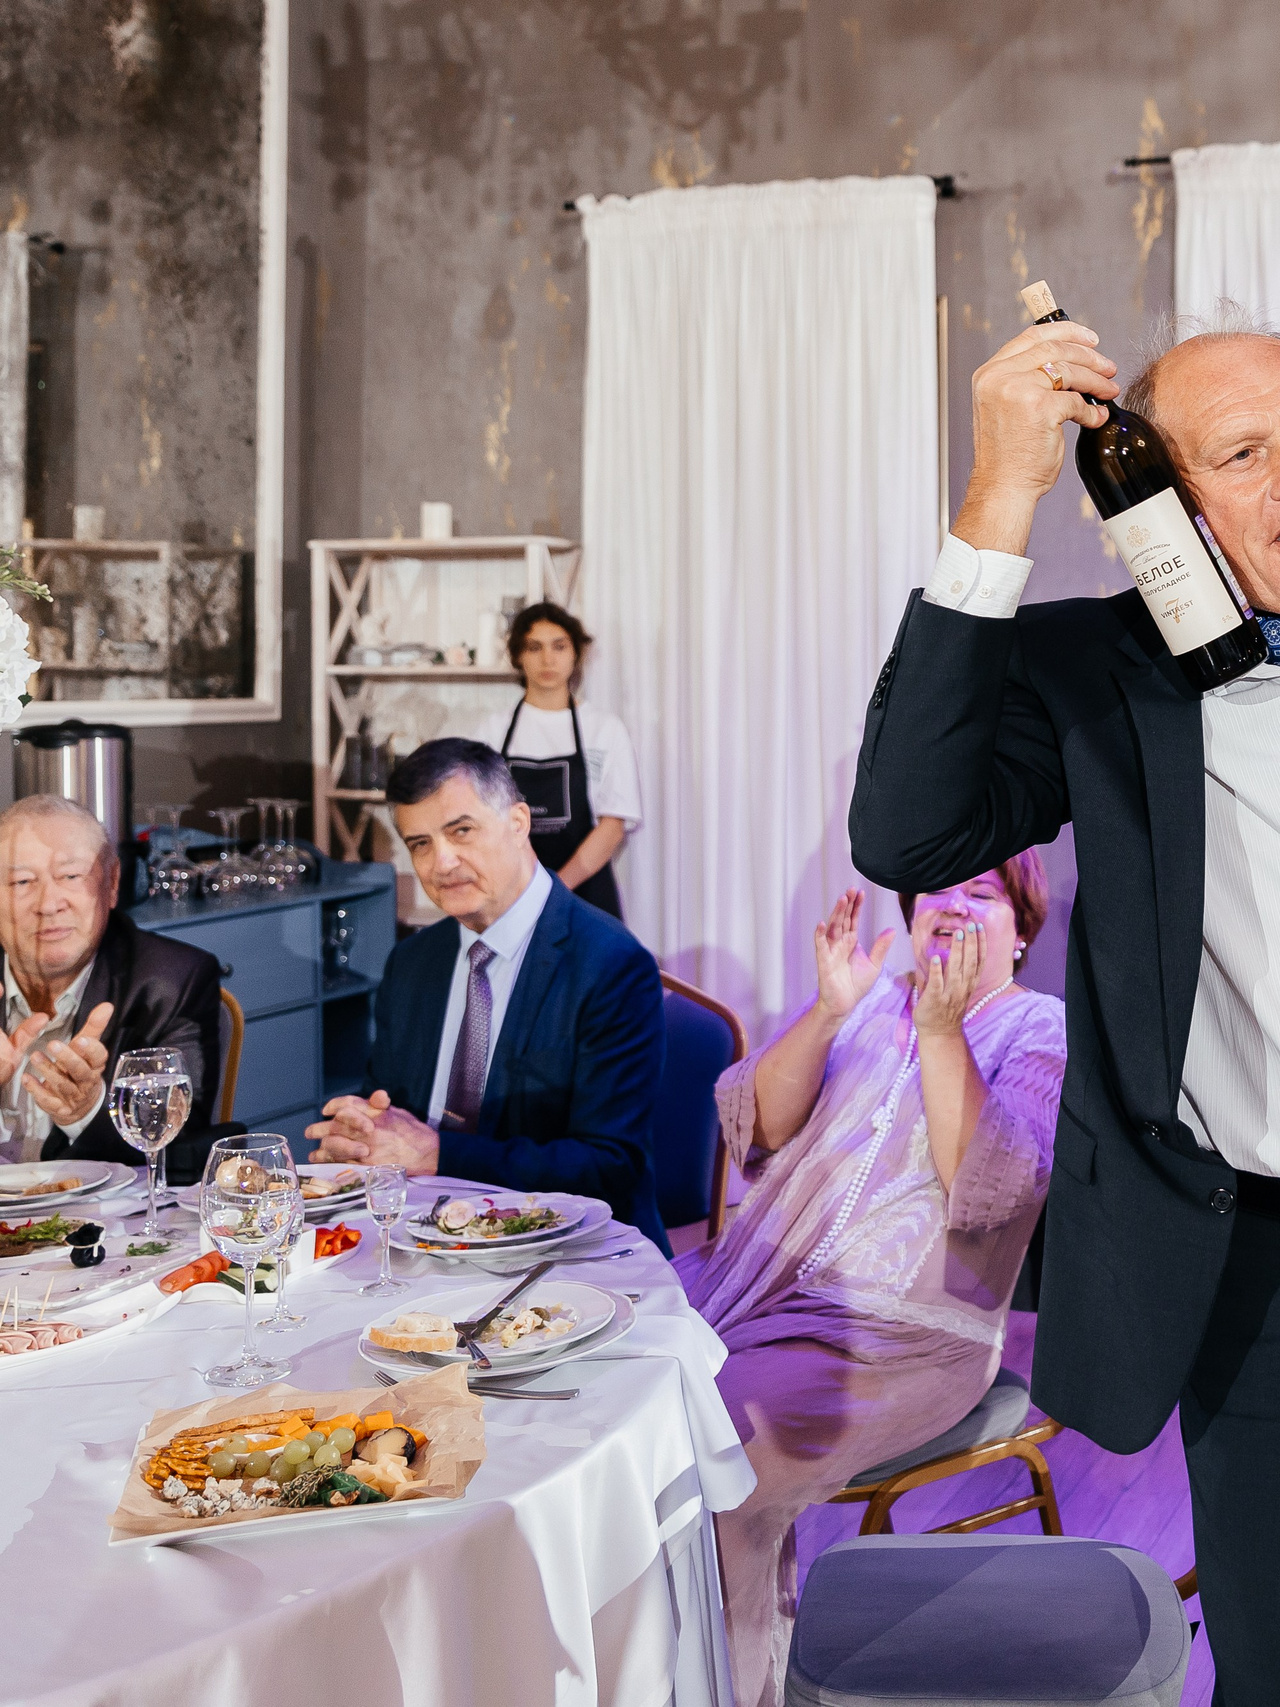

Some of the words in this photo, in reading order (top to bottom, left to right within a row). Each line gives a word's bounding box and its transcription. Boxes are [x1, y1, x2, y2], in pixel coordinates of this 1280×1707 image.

[1135, 555, 1186, 587] БЕЛОЕ
[1143, 571, 1191, 597] ПОЛУСЛАДКОЕ
[1161, 600, 1193, 619] VINTREST
